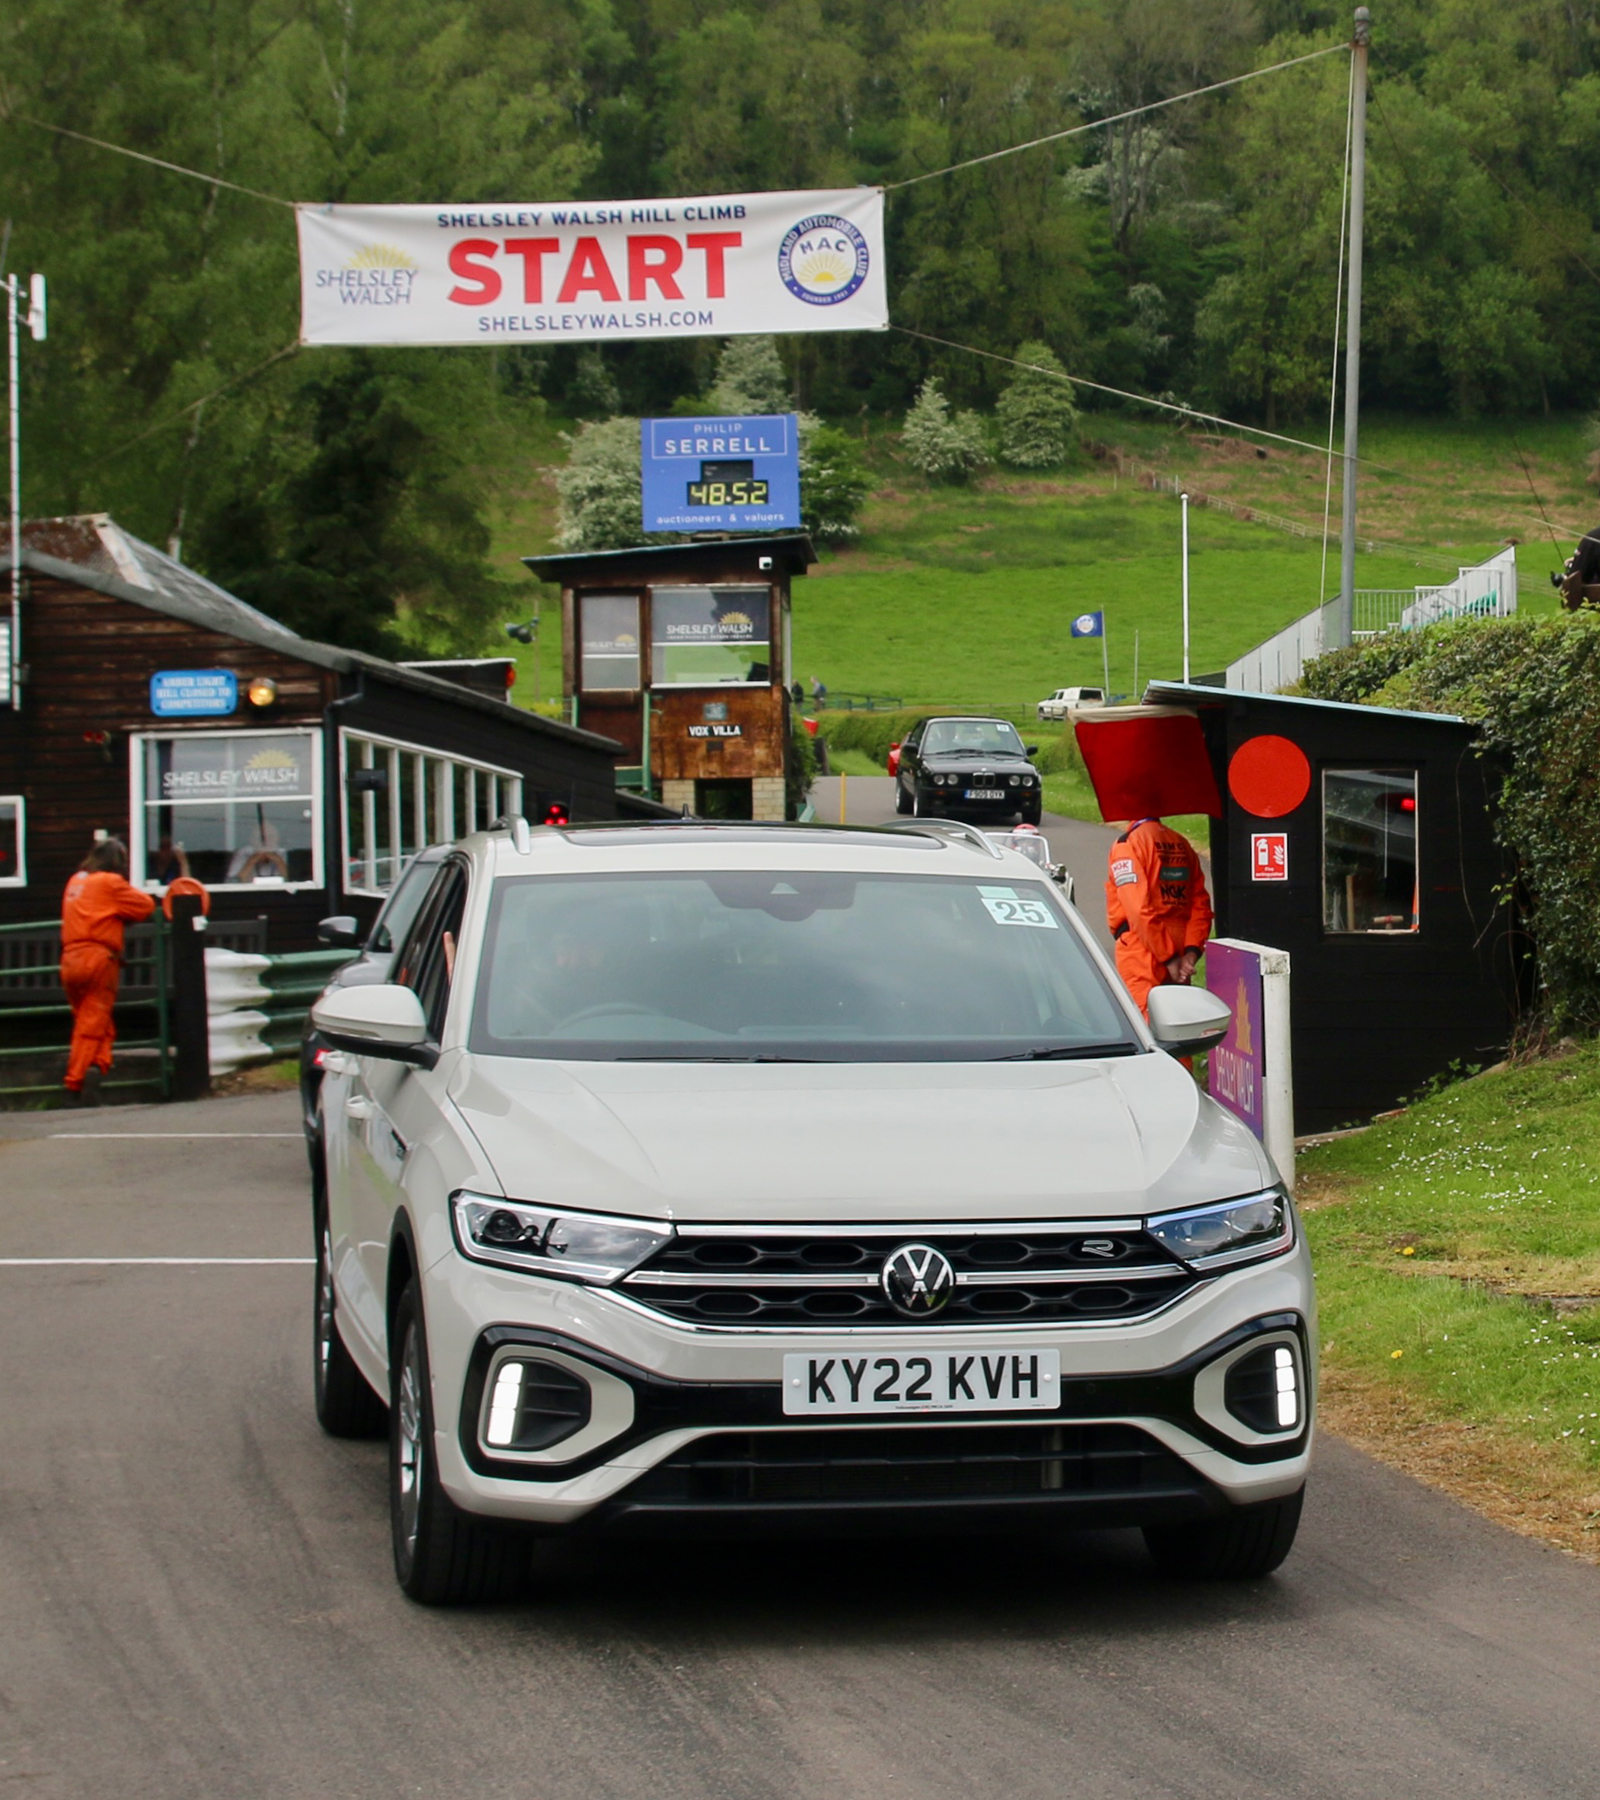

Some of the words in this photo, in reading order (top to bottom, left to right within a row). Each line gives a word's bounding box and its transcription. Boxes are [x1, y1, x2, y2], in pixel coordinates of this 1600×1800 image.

[437, 211, 543, 228] SHELSLEY
[551, 209, 623, 225] WALSH
[630, 208, 676, 223] HILL
[683, 205, 746, 220] CLIMB
[780, 231, 799, 281] MIDLAND
[798, 215, 863, 247] AUTOMOBILE
[855, 247, 869, 277] CLUB
[799, 237, 848, 255] MAC
[447, 231, 743, 306] START
[316, 269, 419, 288] SHELSLEY
[339, 286, 411, 305] WALSH
[479, 311, 713, 332] SHELSLEYWALSH.COM
[694, 423, 743, 434] PHILIP
[665, 437, 771, 454] SERRELL
[690, 482, 767, 506] 48.52
[656, 513, 721, 524] auctioneers
[729, 513, 737, 522] &
[744, 513, 785, 522] valuers
[666, 624, 716, 635] SHELSLEY
[718, 622, 753, 634] WALSH
[689, 725, 709, 736] VOX
[712, 725, 742, 736] VILLA
[163, 769, 241, 787] SHELSLEY
[243, 767, 299, 784] WALSH
[995, 901, 1046, 924] 25
[808, 1356, 932, 1403] KY22
[948, 1354, 1039, 1400] KVH
